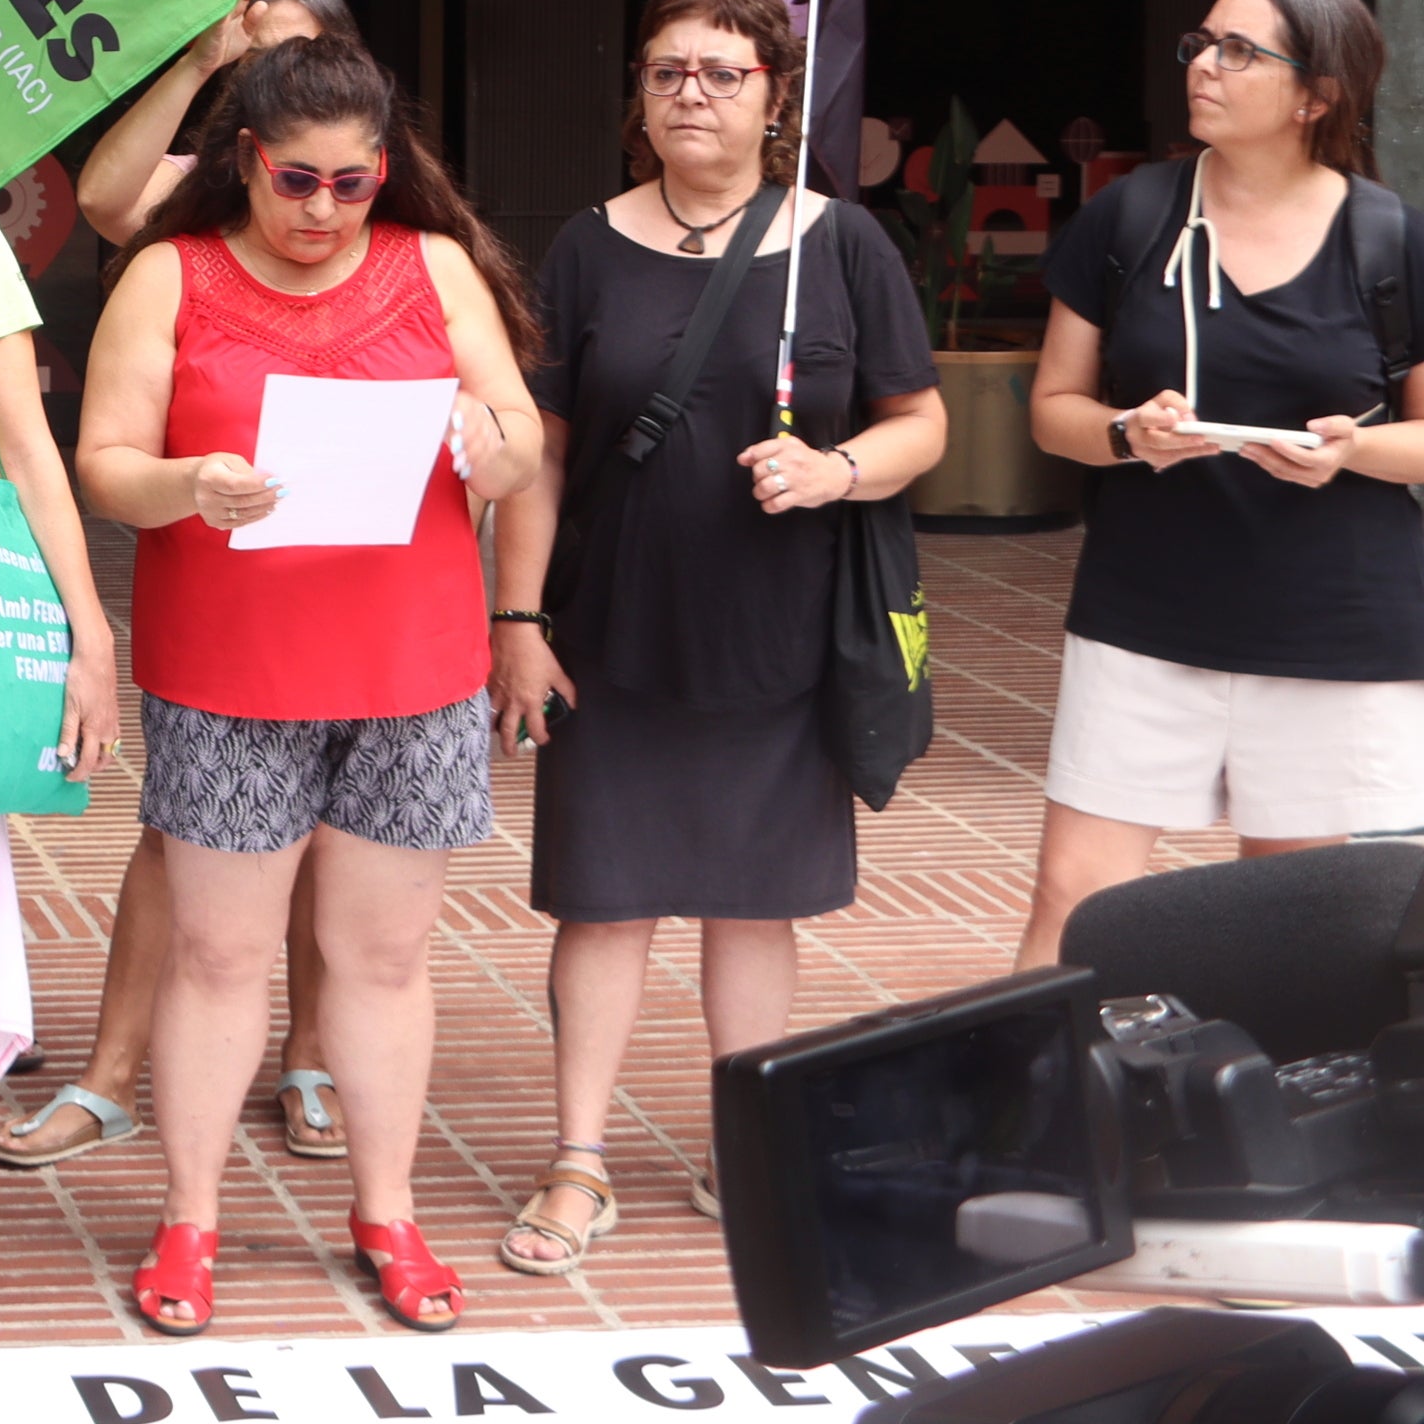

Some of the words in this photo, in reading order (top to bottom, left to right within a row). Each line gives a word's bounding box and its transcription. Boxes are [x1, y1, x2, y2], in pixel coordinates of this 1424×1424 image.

[17, 632, 46, 652] una
[71, 1366, 279, 1424] DE
[345, 1363, 557, 1418] LA
